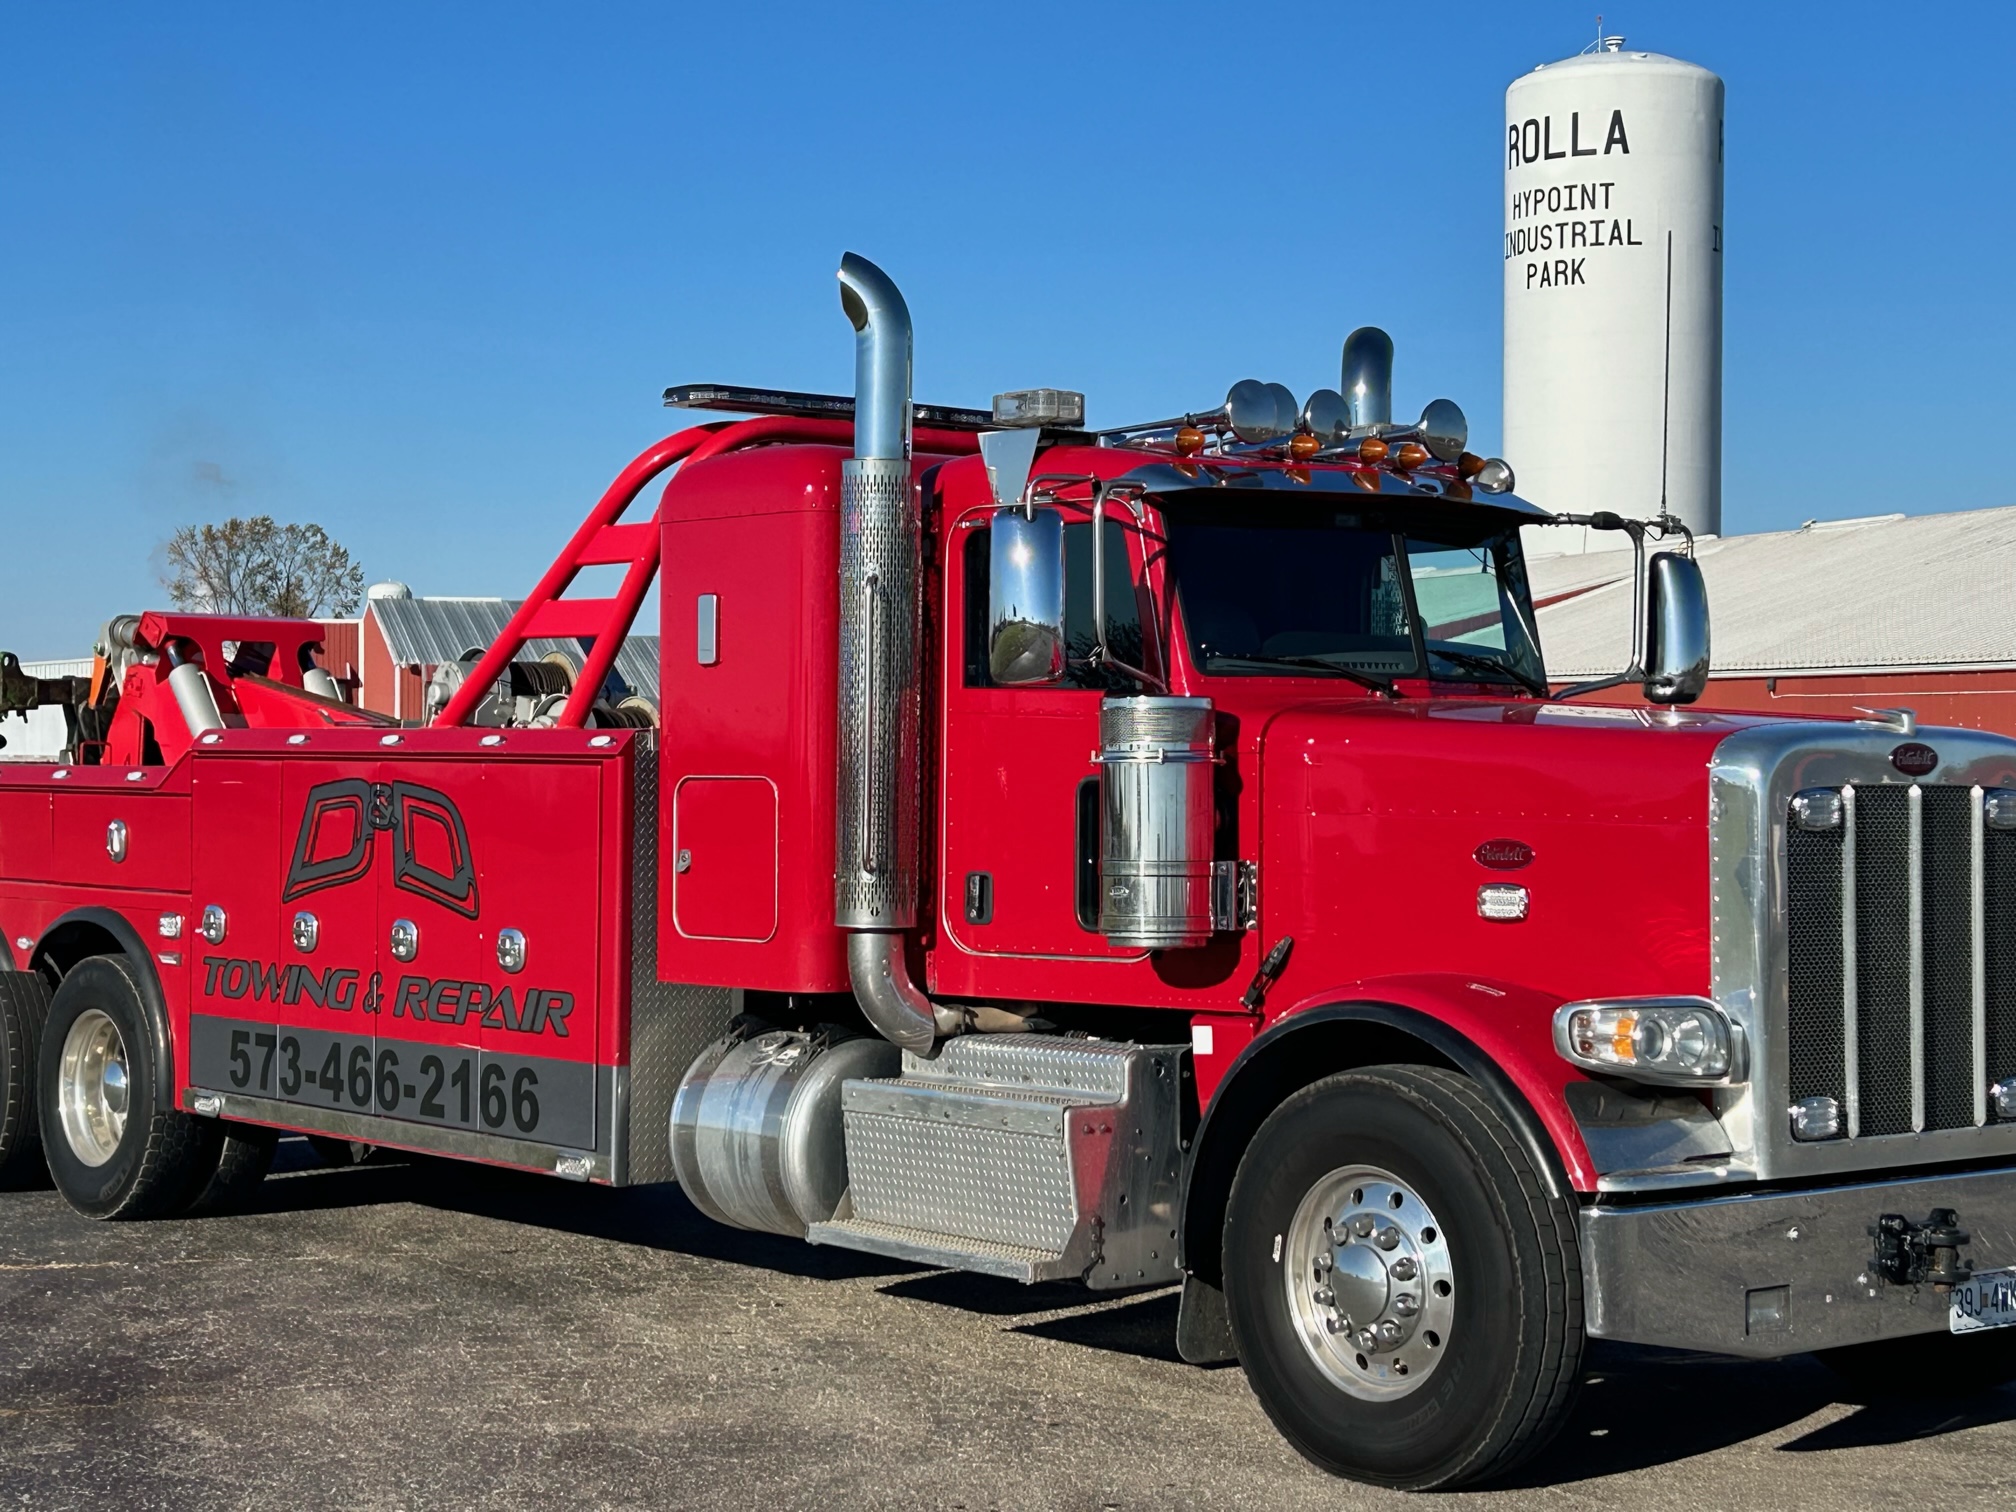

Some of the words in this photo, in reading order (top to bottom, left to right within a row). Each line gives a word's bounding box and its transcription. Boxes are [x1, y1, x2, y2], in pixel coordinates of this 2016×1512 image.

[1508, 109, 1630, 170] ROLLA
[1513, 182, 1615, 220] HYPOINT
[1505, 218, 1643, 260] INDUSTRIAL
[1526, 257, 1586, 290] PARK
[282, 777, 480, 921] D&D
[203, 956, 359, 1011] TOWING
[363, 971, 385, 1015] &
[393, 975, 575, 1038] REPAIR
[229, 1029, 540, 1133] 573-466-2166
